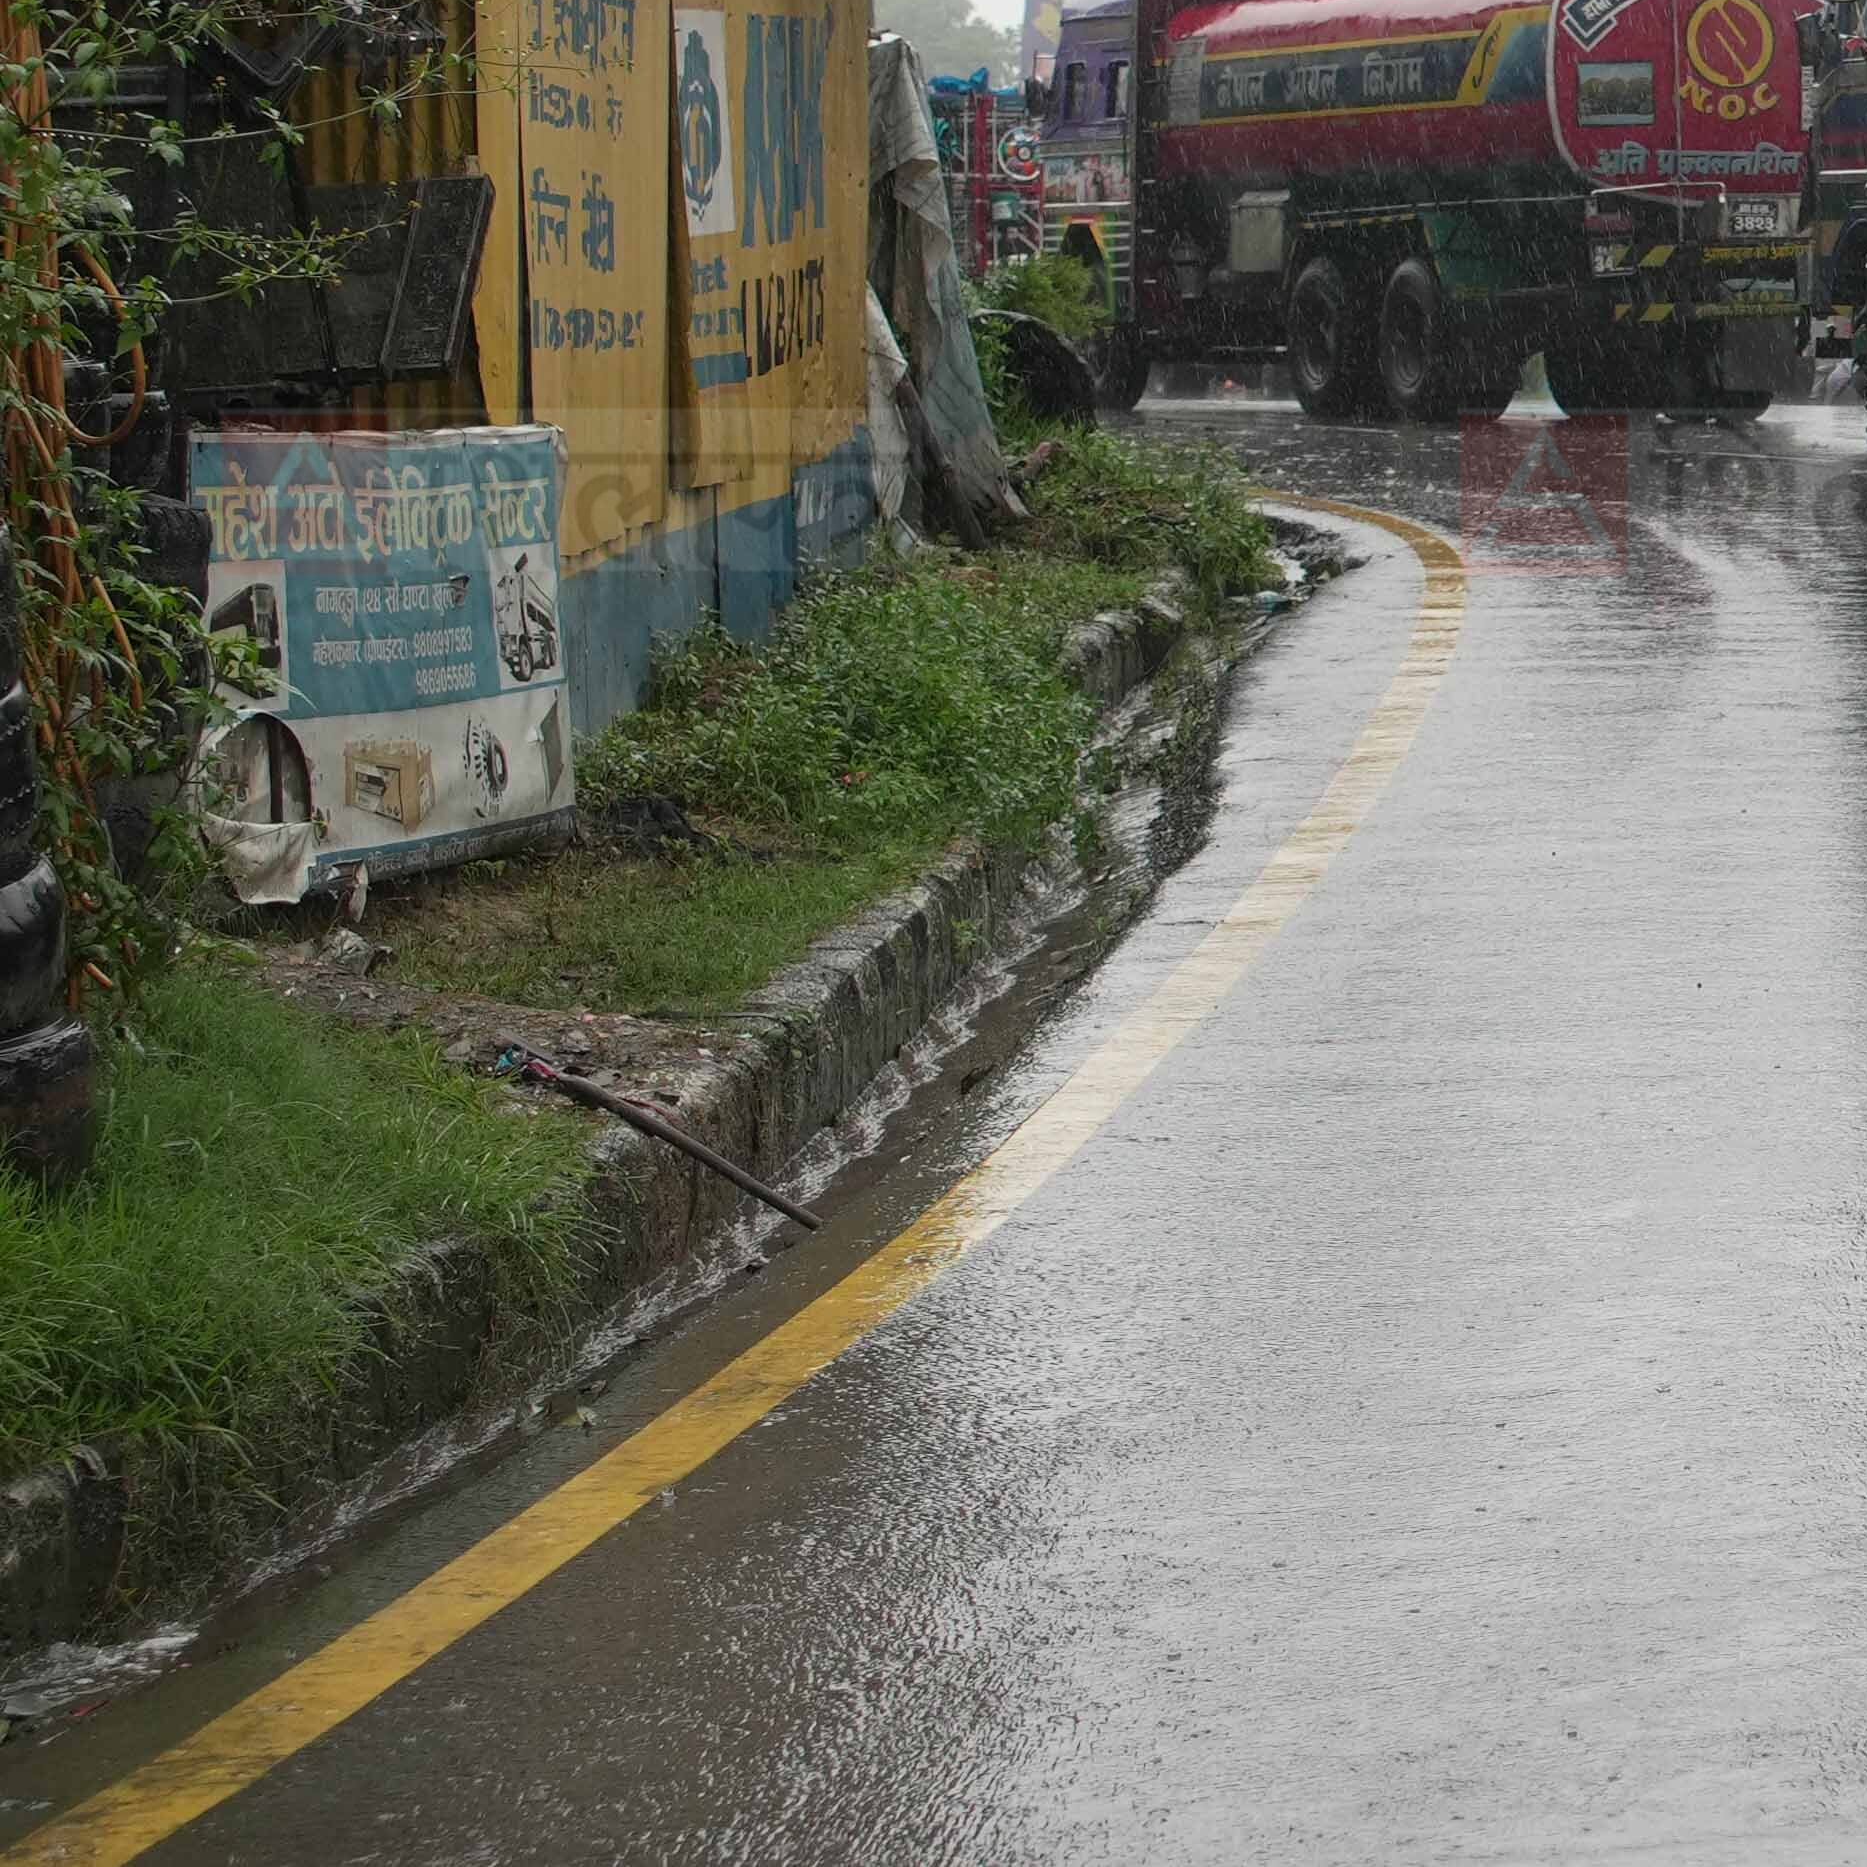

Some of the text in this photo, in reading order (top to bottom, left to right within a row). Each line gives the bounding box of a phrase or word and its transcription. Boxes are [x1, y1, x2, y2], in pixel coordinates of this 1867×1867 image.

[194, 460, 279, 560] महेश
[287, 461, 345, 553] अटो
[402, 584, 430, 612] घण्टा
